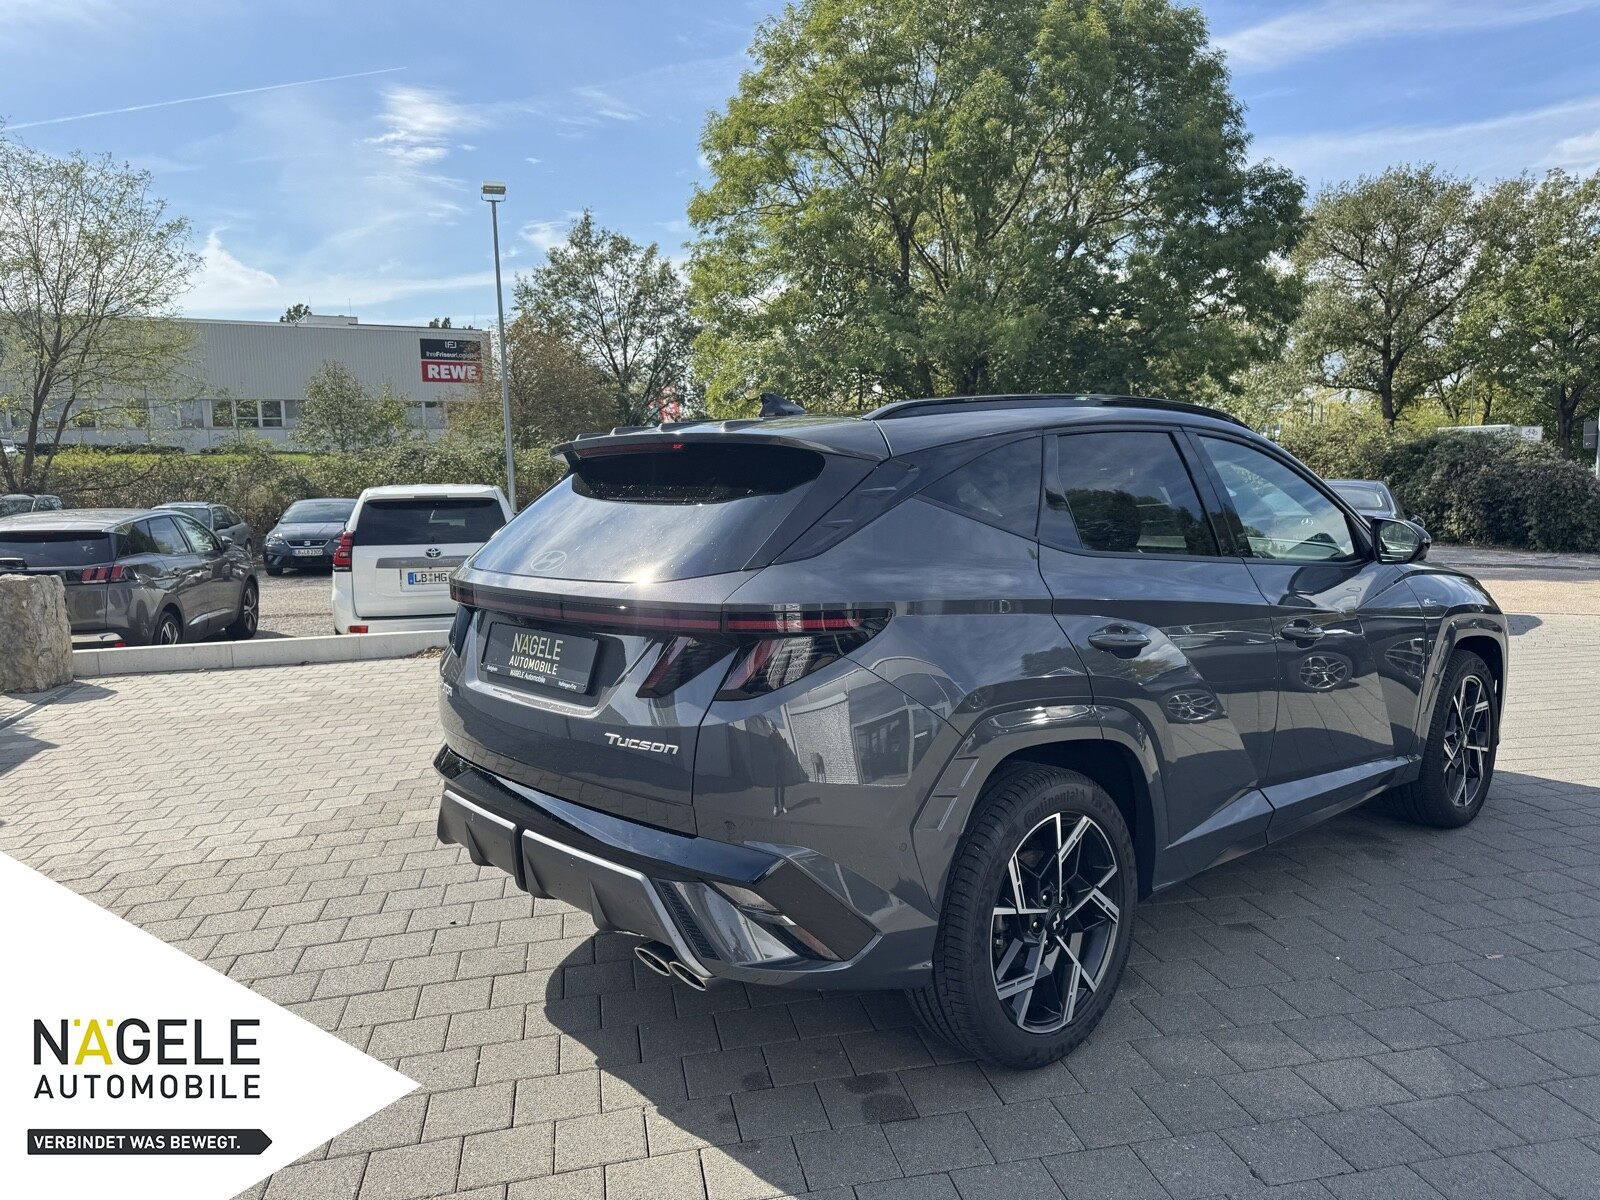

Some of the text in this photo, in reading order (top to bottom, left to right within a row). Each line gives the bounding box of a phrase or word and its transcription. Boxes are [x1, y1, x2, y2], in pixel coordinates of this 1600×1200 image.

[427, 364, 477, 380] REWE
[414, 572, 448, 583] LB HG
[512, 632, 563, 661] NÄGELE
[508, 654, 559, 676] AUTOMOBILE
[524, 672, 546, 684] Automobile
[1024, 788, 1080, 829] Continental
